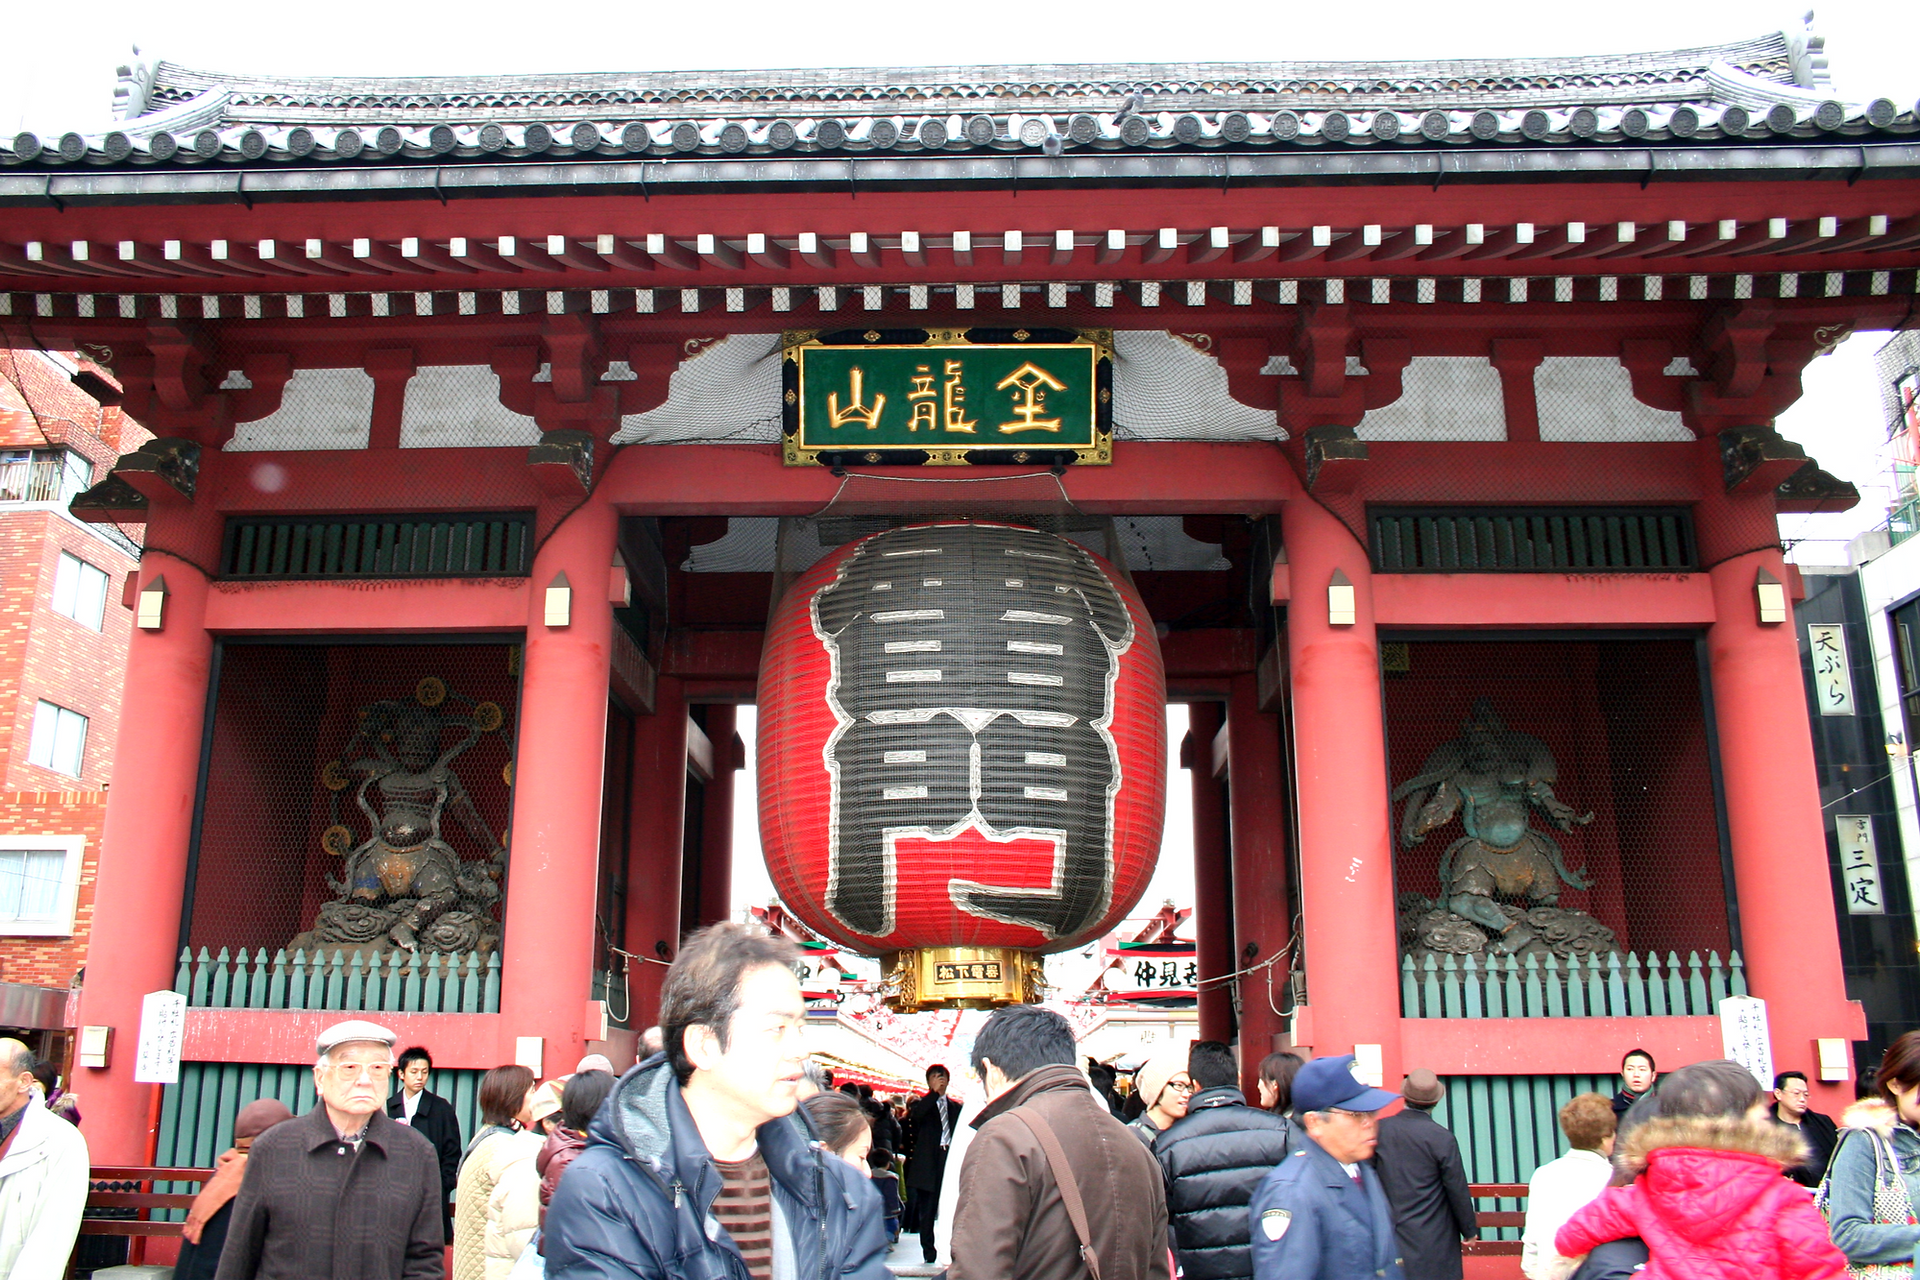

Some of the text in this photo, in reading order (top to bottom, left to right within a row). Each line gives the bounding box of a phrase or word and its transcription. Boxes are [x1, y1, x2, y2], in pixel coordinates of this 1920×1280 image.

[810, 524, 1135, 939] 雷門
[939, 965, 999, 979] 松下電器
